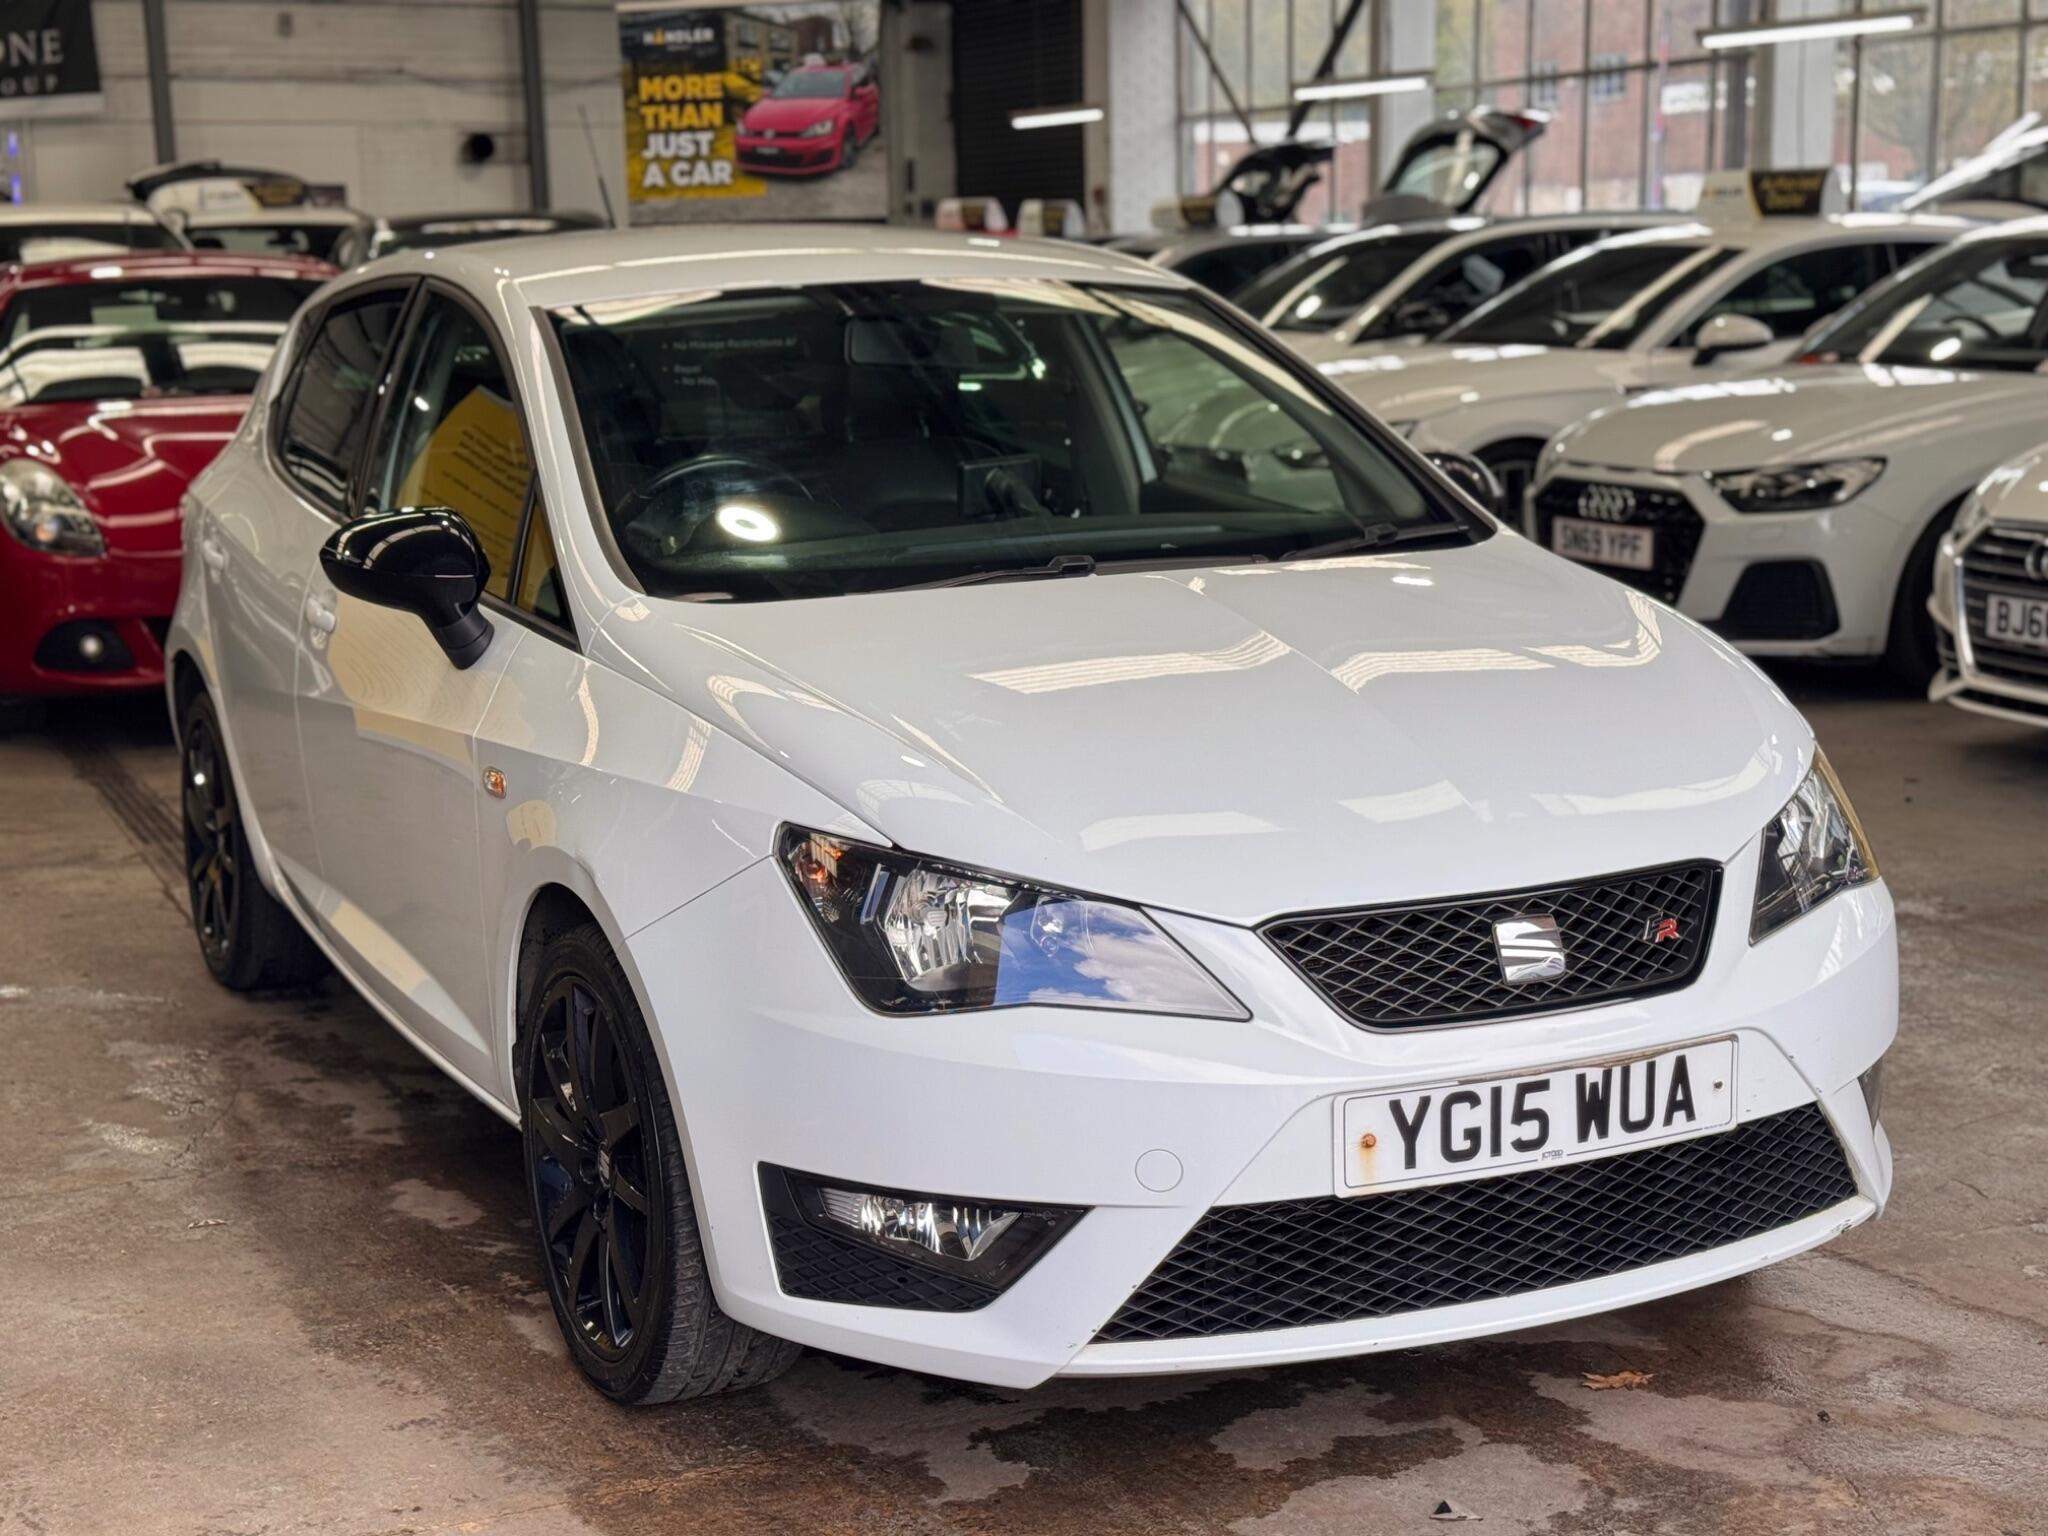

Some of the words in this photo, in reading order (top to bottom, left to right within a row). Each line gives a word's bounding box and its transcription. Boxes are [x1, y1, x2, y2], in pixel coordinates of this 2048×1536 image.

[0, 29, 63, 67] NE
[639, 73, 723, 101] MORE
[640, 102, 723, 129] THAN
[642, 131, 714, 158] JUST
[643, 163, 665, 188] A
[670, 160, 733, 186] CAR
[1997, 600, 2048, 639] BJ6
[1389, 1079, 1551, 1170] YG15
[1575, 1054, 1696, 1144] WUA
